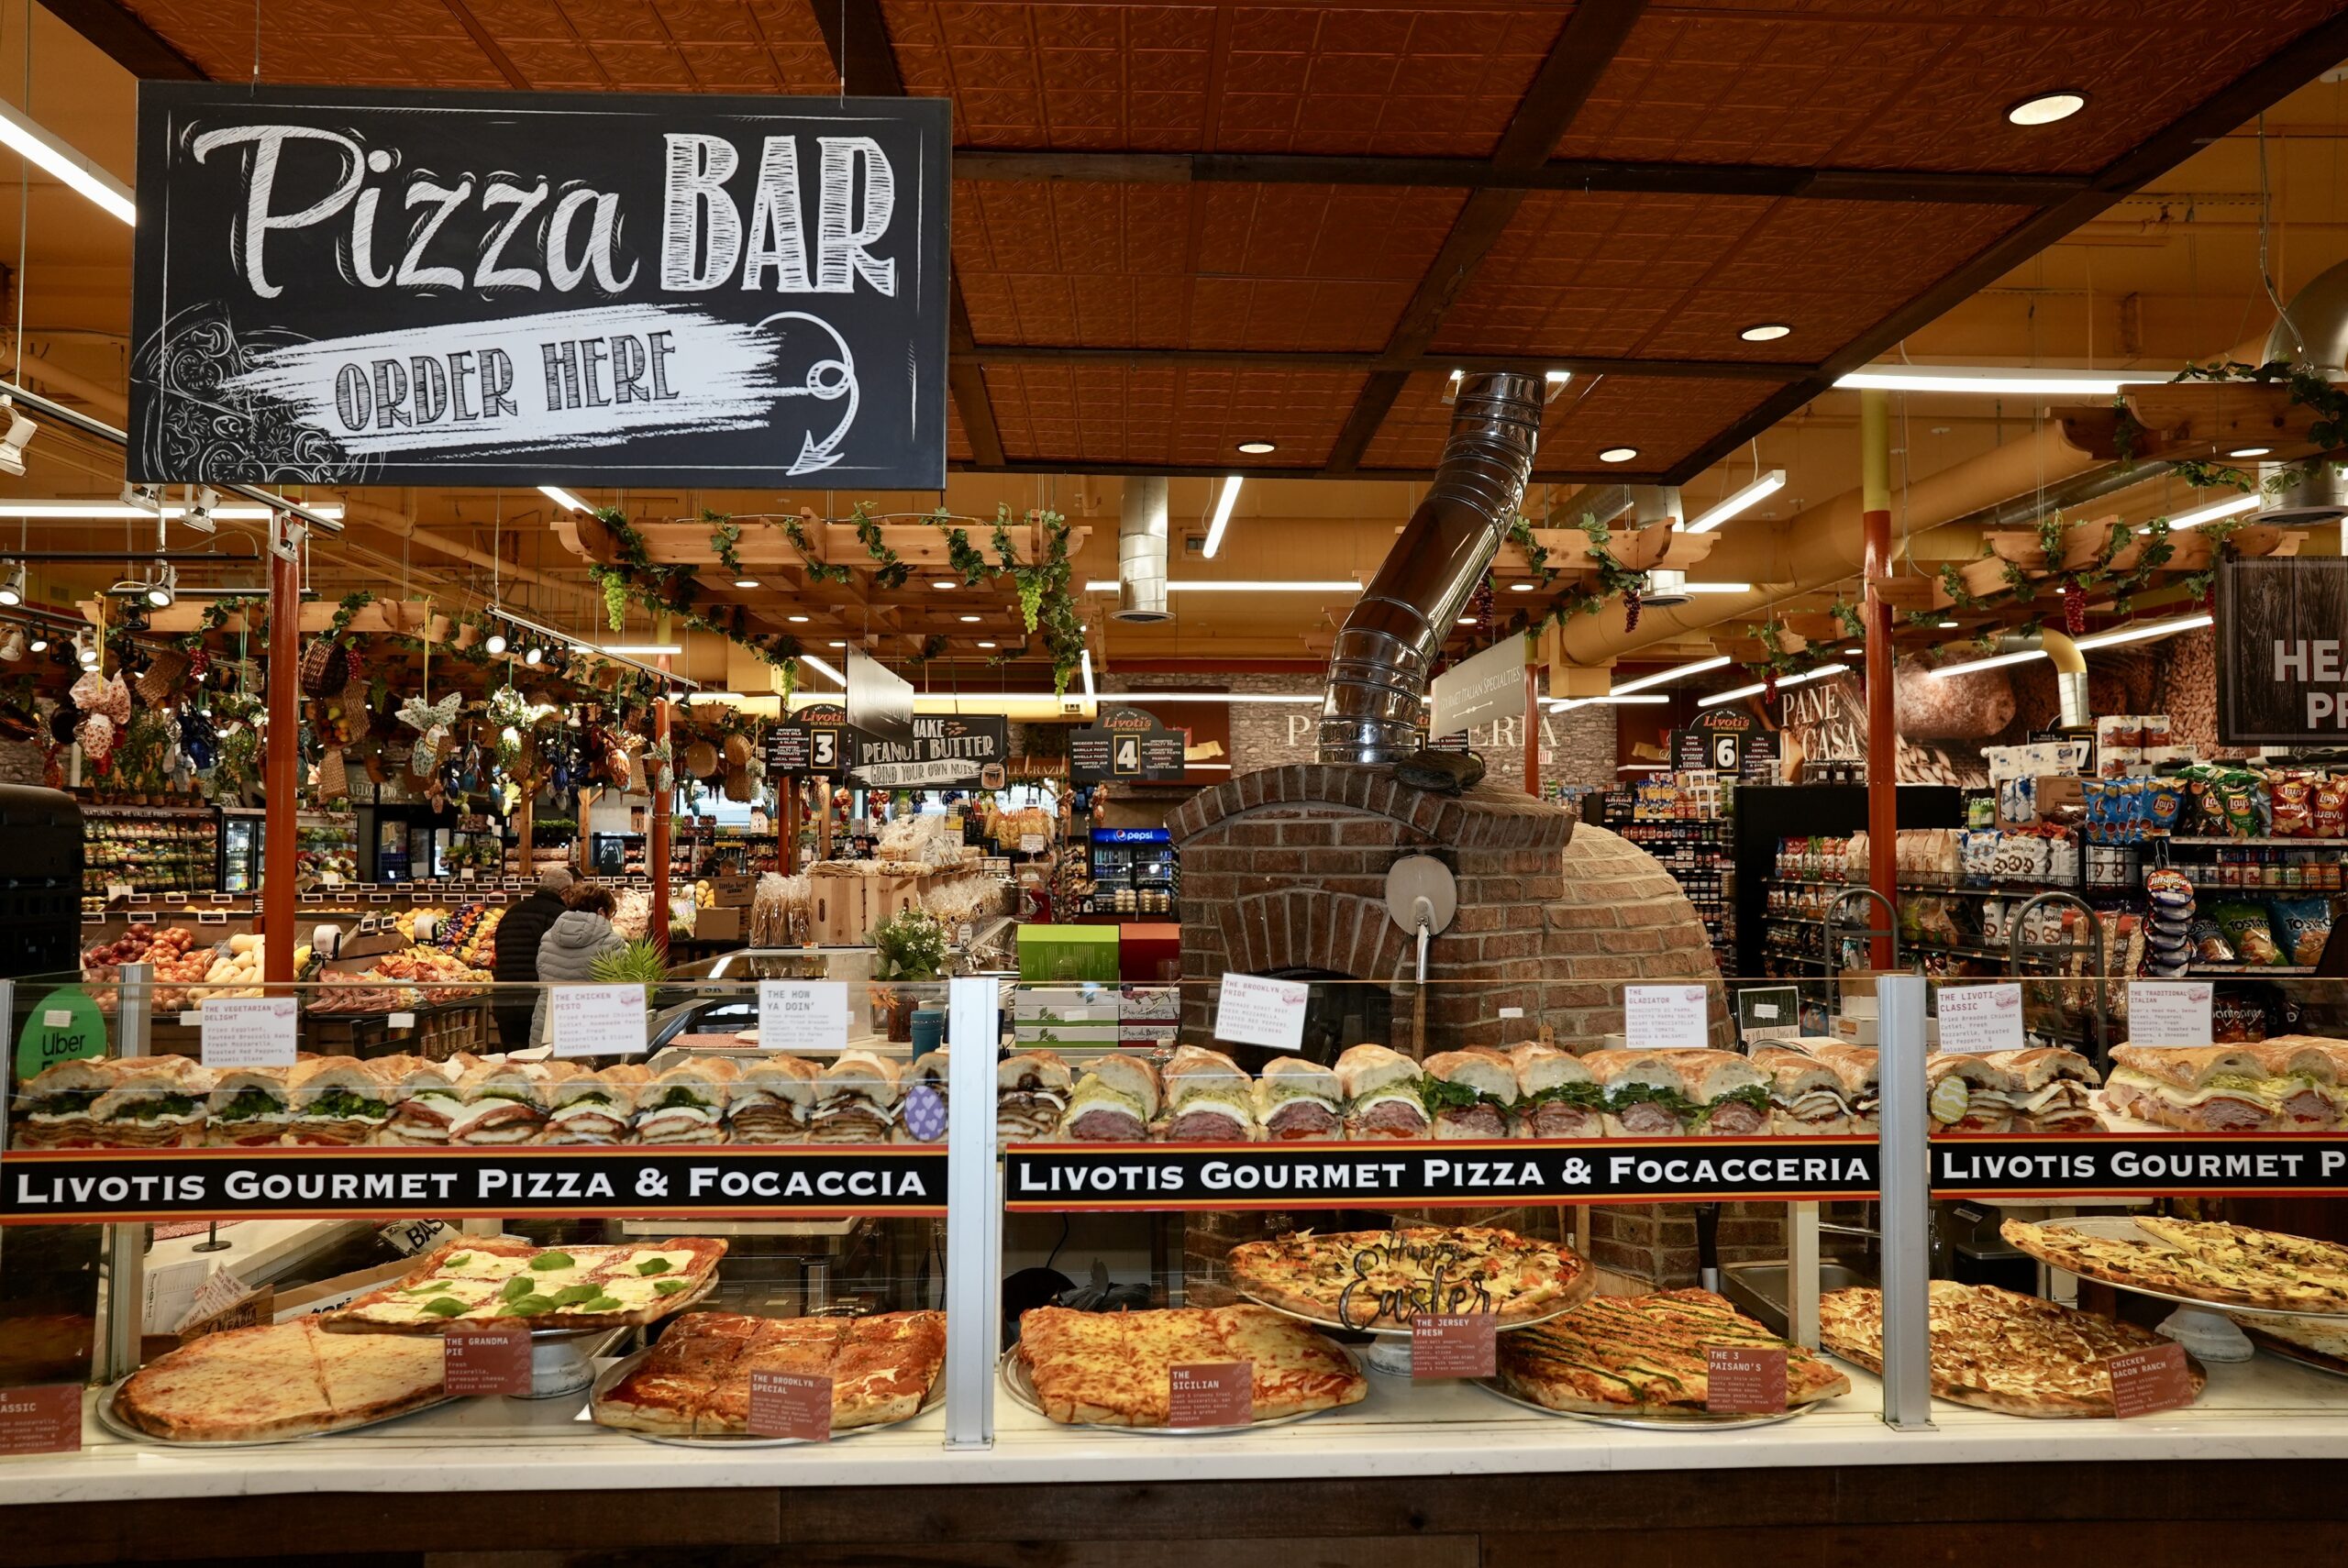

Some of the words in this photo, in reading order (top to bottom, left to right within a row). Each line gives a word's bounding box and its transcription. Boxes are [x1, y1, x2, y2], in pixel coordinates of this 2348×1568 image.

[188, 123, 639, 299] Pizza
[660, 131, 896, 294] BAR
[335, 347, 518, 431] ORDER
[546, 329, 679, 412] HERE
[2275, 639, 2348, 681] HE
[1441, 690, 1463, 712] GOURMET
[1462, 682, 1482, 702] ITALIAN
[1484, 666, 1521, 697] SPECIALTIES
[1781, 683, 1840, 726] PANE
[1703, 715, 1750, 727] Livoti's
[929, 735, 994, 759] BUTTER
[1802, 722, 1861, 761] CASA
[814, 734, 833, 763] 3
[1117, 740, 1137, 768] 4
[1716, 738, 1735, 767] 6
[2075, 740, 2090, 767] 7
[870, 765, 897, 785] GRIND
[901, 766, 924, 781] YOUR
[927, 764, 947, 778] OWN
[950, 763, 973, 776] NUTS
[2154, 797, 2175, 811] Lay's
[1127, 831, 1153, 841] pepsi
[767, 990, 785, 999] THE
[792, 990, 810, 999] HOW
[1224, 988, 1246, 998] PRIDE
[1244, 983, 1279, 993] BROOKLYN
[1939, 993, 1955, 1001] THE
[1961, 991, 1994, 999] LIVOTI
[767, 1002, 779, 1010] YA
[785, 1002, 814, 1010] DOIN'
[1940, 1002, 1978, 1012] CLASSIC
[42, 1032, 85, 1056] Uber
[1943, 1151, 2096, 1179] LIVOTIS
[2110, 1151, 2304, 1178] GOURMET
[1019, 1161, 1184, 1192] LIVOTIS
[1200, 1160, 1406, 1189] GOURMET
[1423, 1158, 1545, 1187] PIZZA
[1562, 1156, 1591, 1185] &
[1610, 1155, 1871, 1184] FOCACCERIA
[17, 1173, 206, 1205] LIVOTIS
[224, 1169, 458, 1202] GOURMET
[478, 1168, 615, 1199] PIZZA
[635, 1166, 669, 1198] &
[689, 1166, 927, 1198] FOCACCIA
[1339, 1249, 1504, 1331] Easter
[1416, 1319, 1433, 1327] THE
[1437, 1318, 1469, 1327] JERSEY
[1416, 1329, 1443, 1337] FRESH
[447, 1337, 463, 1346] THE
[468, 1337, 509, 1346] GRANDMA
[447, 1348, 463, 1356] PIE
[1711, 1351, 1728, 1360] THE
[1733, 1352, 1739, 1360] 3
[1710, 1362, 1761, 1372] PAISANO'S
[2111, 1356, 2145, 1369] CHICKEN
[1172, 1371, 1190, 1379] THE
[2113, 1367, 2138, 1378] BACON
[2142, 1361, 2166, 1373] RANCH
[753, 1375, 768, 1383] THE
[772, 1376, 814, 1387] BROOKLYN
[1172, 1380, 1219, 1390] SICILIAN
[752, 1384, 788, 1395] SPECIAL
